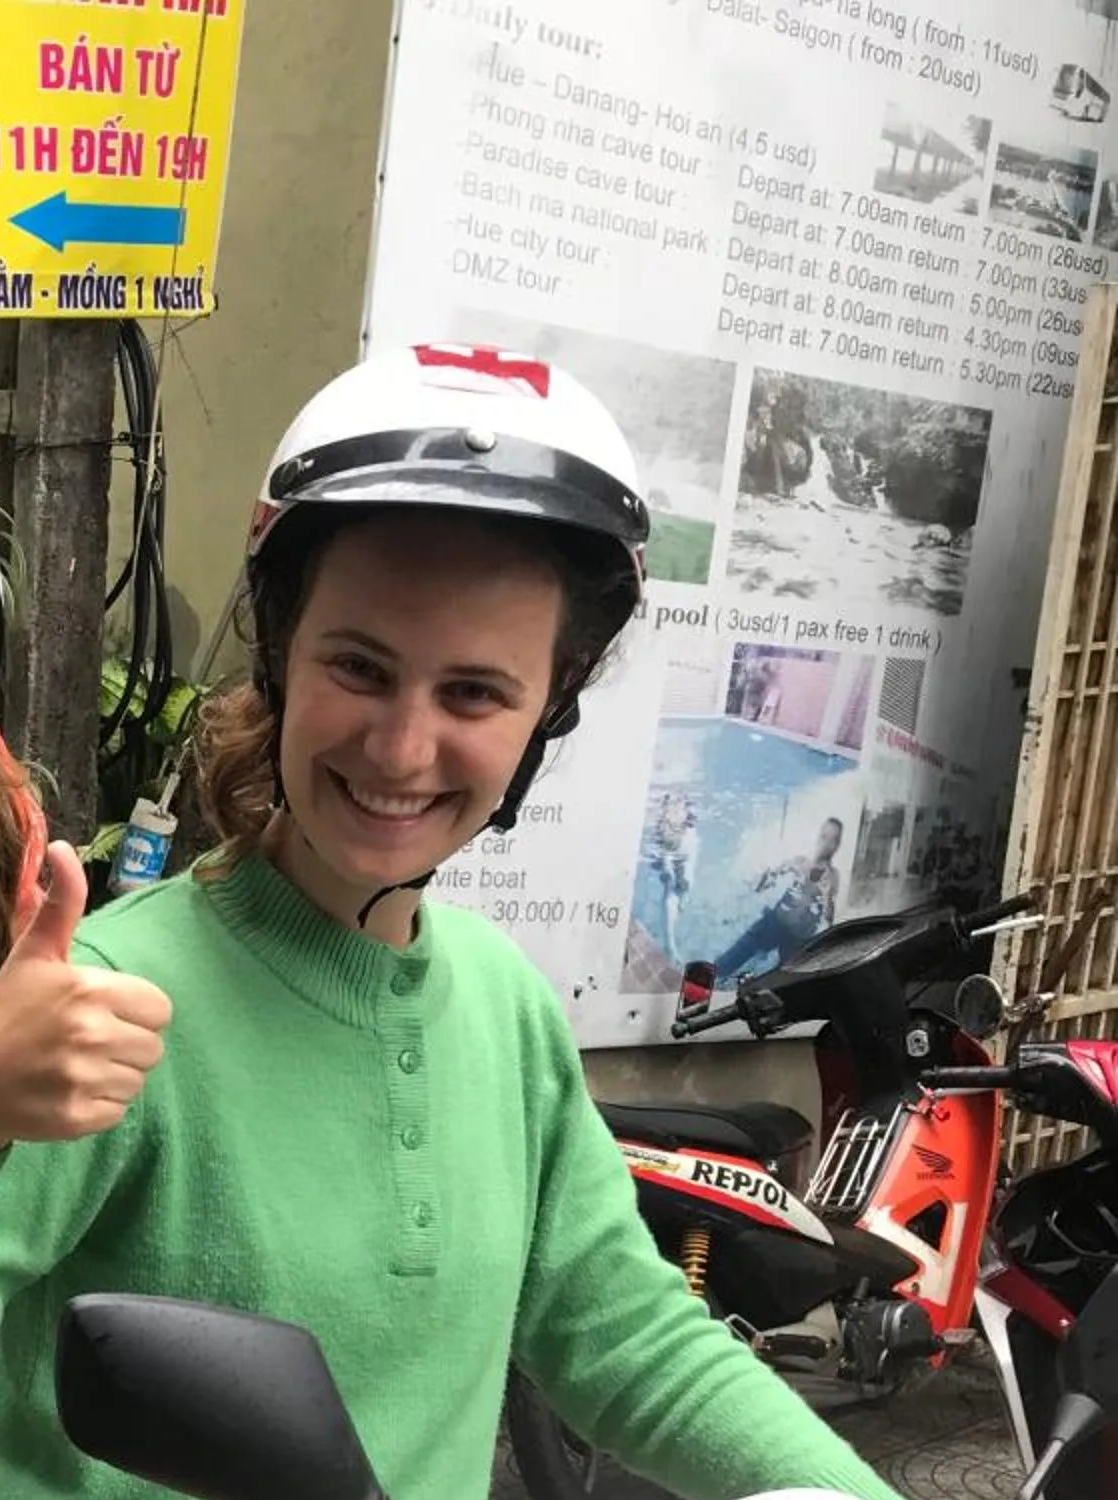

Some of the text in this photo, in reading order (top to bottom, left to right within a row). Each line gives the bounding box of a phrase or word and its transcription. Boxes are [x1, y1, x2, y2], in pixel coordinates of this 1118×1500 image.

[538, 22, 603, 59] tour:
[774, 8, 841, 51] Saigon
[861, 35, 903, 70] from
[867, 4, 907, 39] long
[925, 20, 965, 50] from
[40, 34, 180, 98] BÁN TỪ
[71, 115, 144, 177] ĐẾN
[156, 135, 208, 181] 19H
[554, 120, 594, 147] nha
[601, 133, 653, 163] cave
[660, 147, 701, 176] tour
[655, 104, 691, 135] Hoi
[696, 120, 721, 145] an
[464, 129, 678, 207] Paradise cave tour
[454, 211, 599, 266] Hue city tour
[460, 170, 709, 254] Bach ma national park
[737, 163, 804, 202] Depart
[913, 213, 965, 242] return
[1048, 245, 1109, 279] (26usd)
[452, 248, 562, 295] DMZ tour
[732, 200, 799, 239] Depart
[907, 247, 960, 276] return
[1042, 277, 1088, 305] (33us
[135, 277, 144, 309] 1
[727, 236, 794, 275] Depart
[902, 282, 955, 309] return
[1037, 308, 1084, 335] (26us
[718, 307, 783, 346] Depart
[892, 347, 944, 374] return
[722, 272, 789, 311] Depart
[898, 315, 949, 341] return
[1032, 340, 1079, 366] (09us
[655, 605, 710, 629] pool
[728, 609, 789, 635] 3usd/1
[795, 618, 828, 641] pax
[834, 619, 869, 642] free
[889, 627, 931, 649] drink
[481, 837, 516, 854] car
[433, 867, 527, 889] vite boat
[493, 900, 564, 923] 30.000
[586, 903, 619, 928] 1kg
